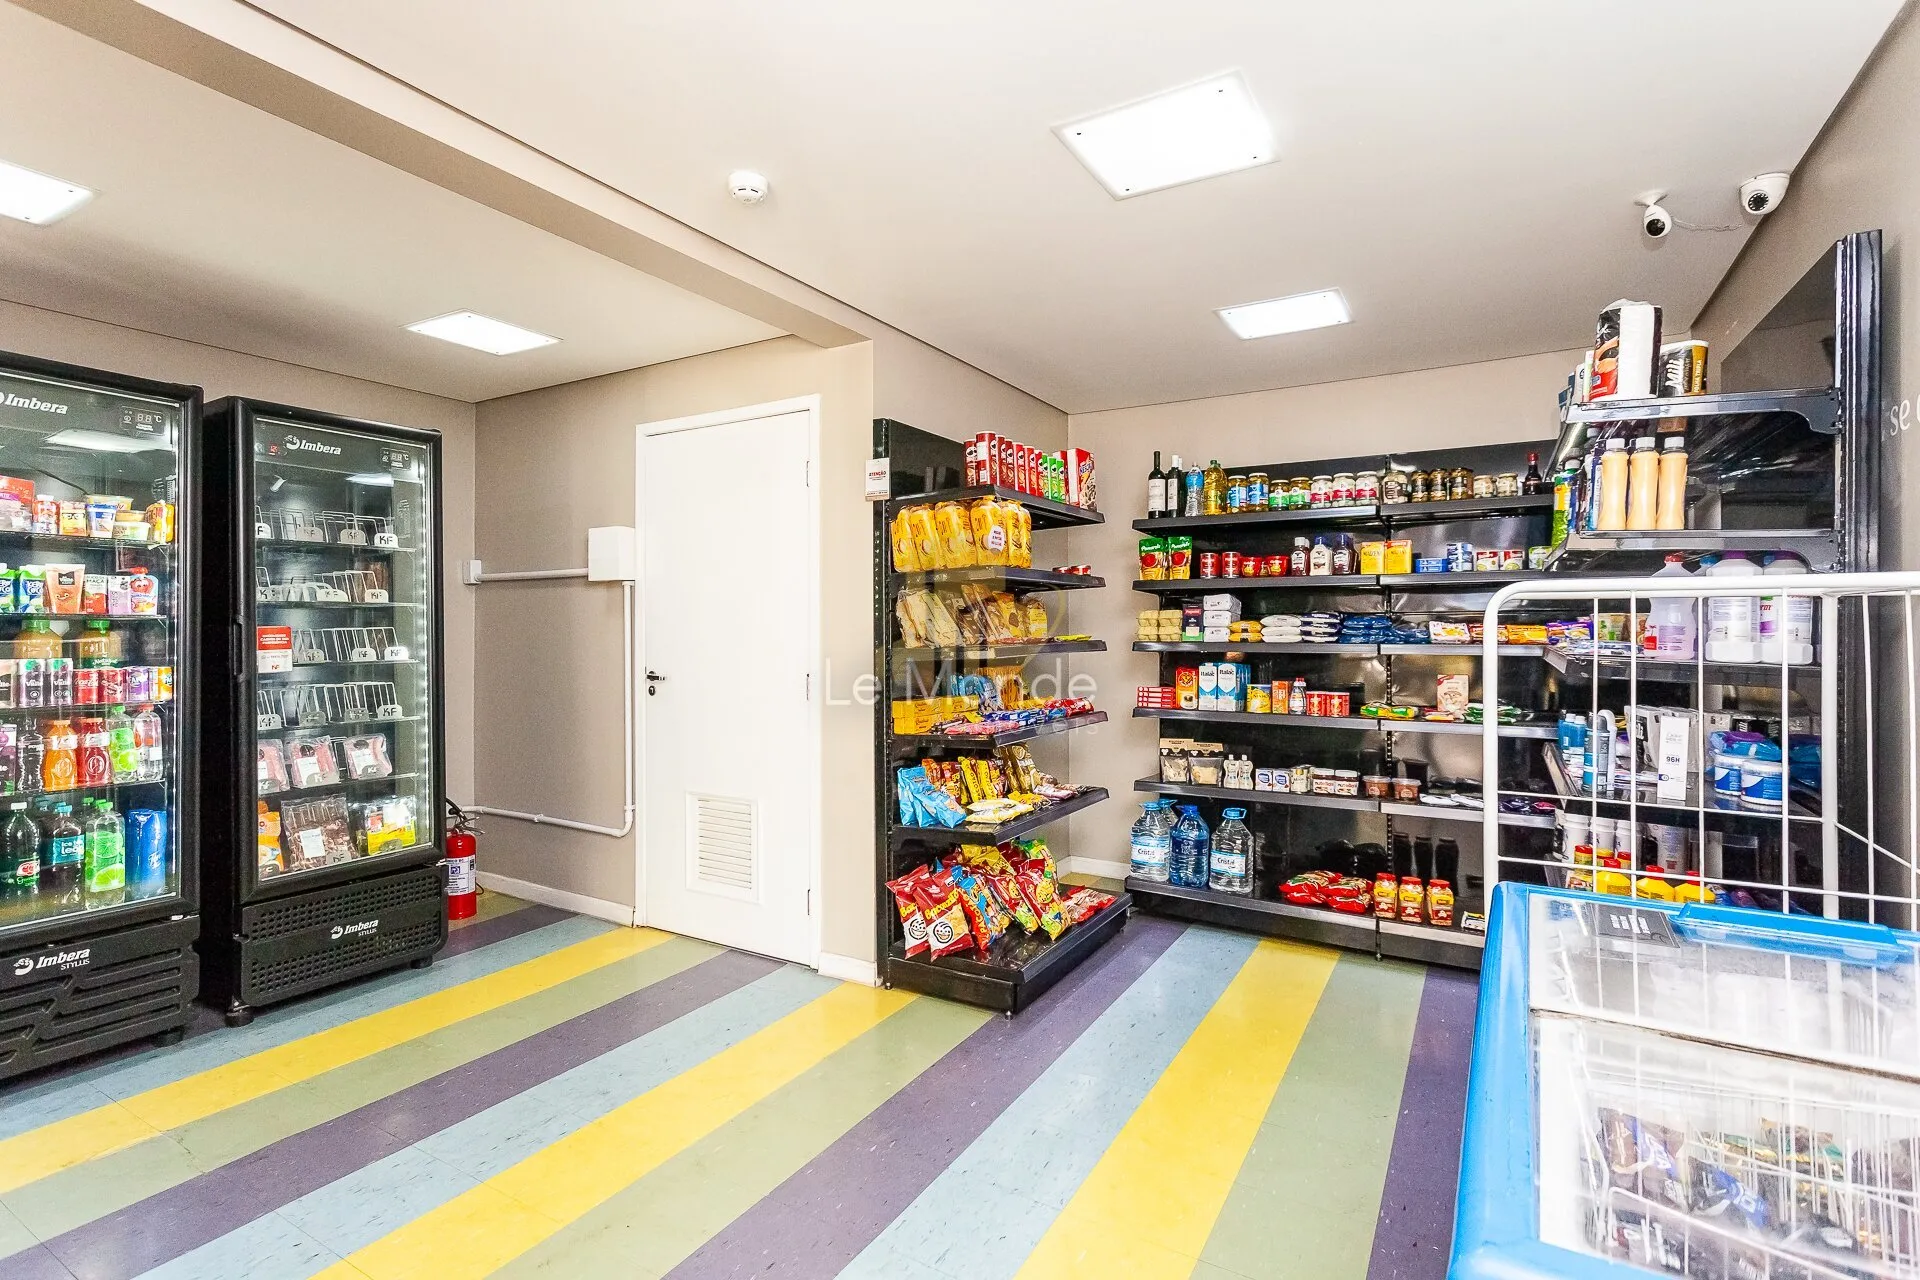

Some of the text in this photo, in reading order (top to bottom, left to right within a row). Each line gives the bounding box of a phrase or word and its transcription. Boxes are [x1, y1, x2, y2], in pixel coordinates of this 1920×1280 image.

[5, 393, 68, 414] Imbera
[300, 439, 342, 455] Imbera
[379, 535, 393, 545] KF
[383, 707, 397, 717] KF
[343, 919, 379, 935] Imbera
[35, 948, 91, 969] Imbera
[60, 958, 90, 970] STYLUS
